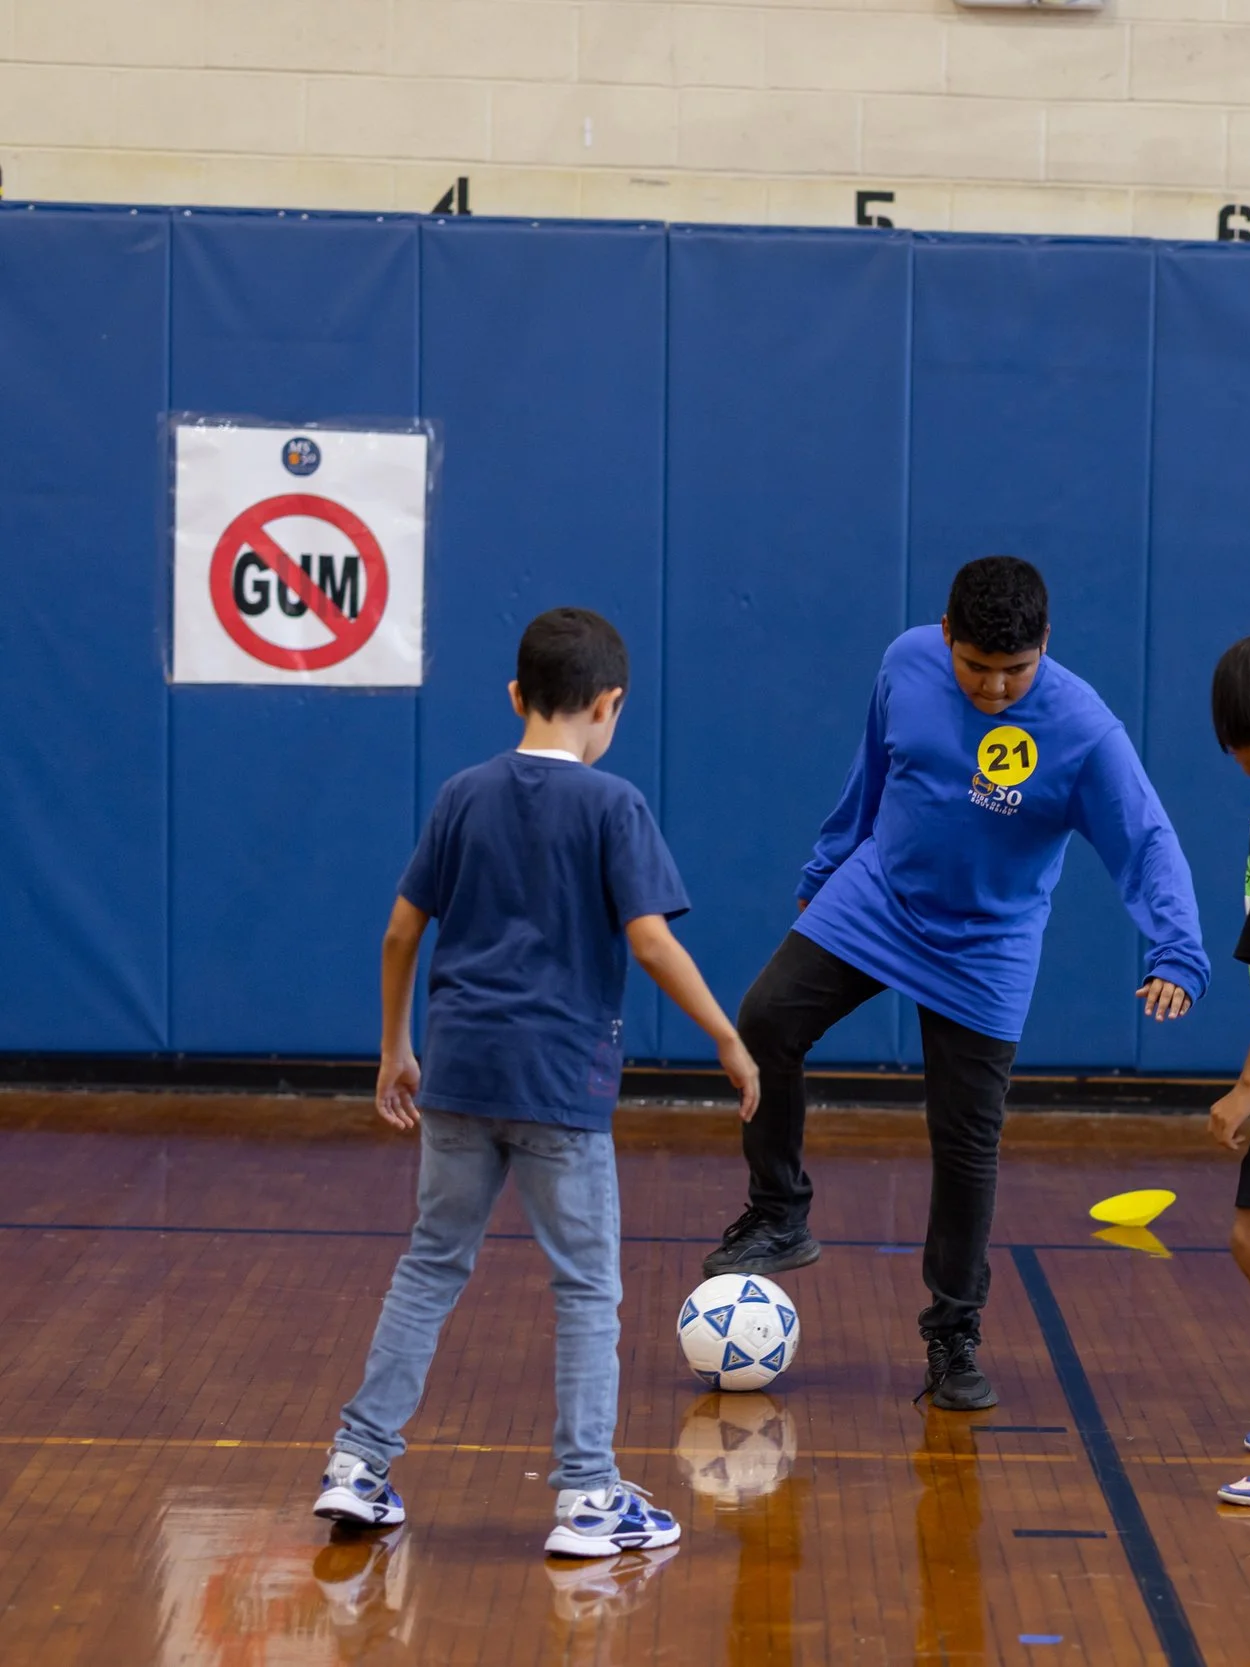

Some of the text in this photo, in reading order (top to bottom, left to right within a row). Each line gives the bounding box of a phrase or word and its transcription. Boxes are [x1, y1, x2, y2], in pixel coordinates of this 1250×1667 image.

[430, 177, 472, 215] 4
[857, 191, 894, 229] 5
[233, 551, 359, 619] GUM
[986, 740, 1029, 772] 21
[992, 785, 1022, 806] 50
